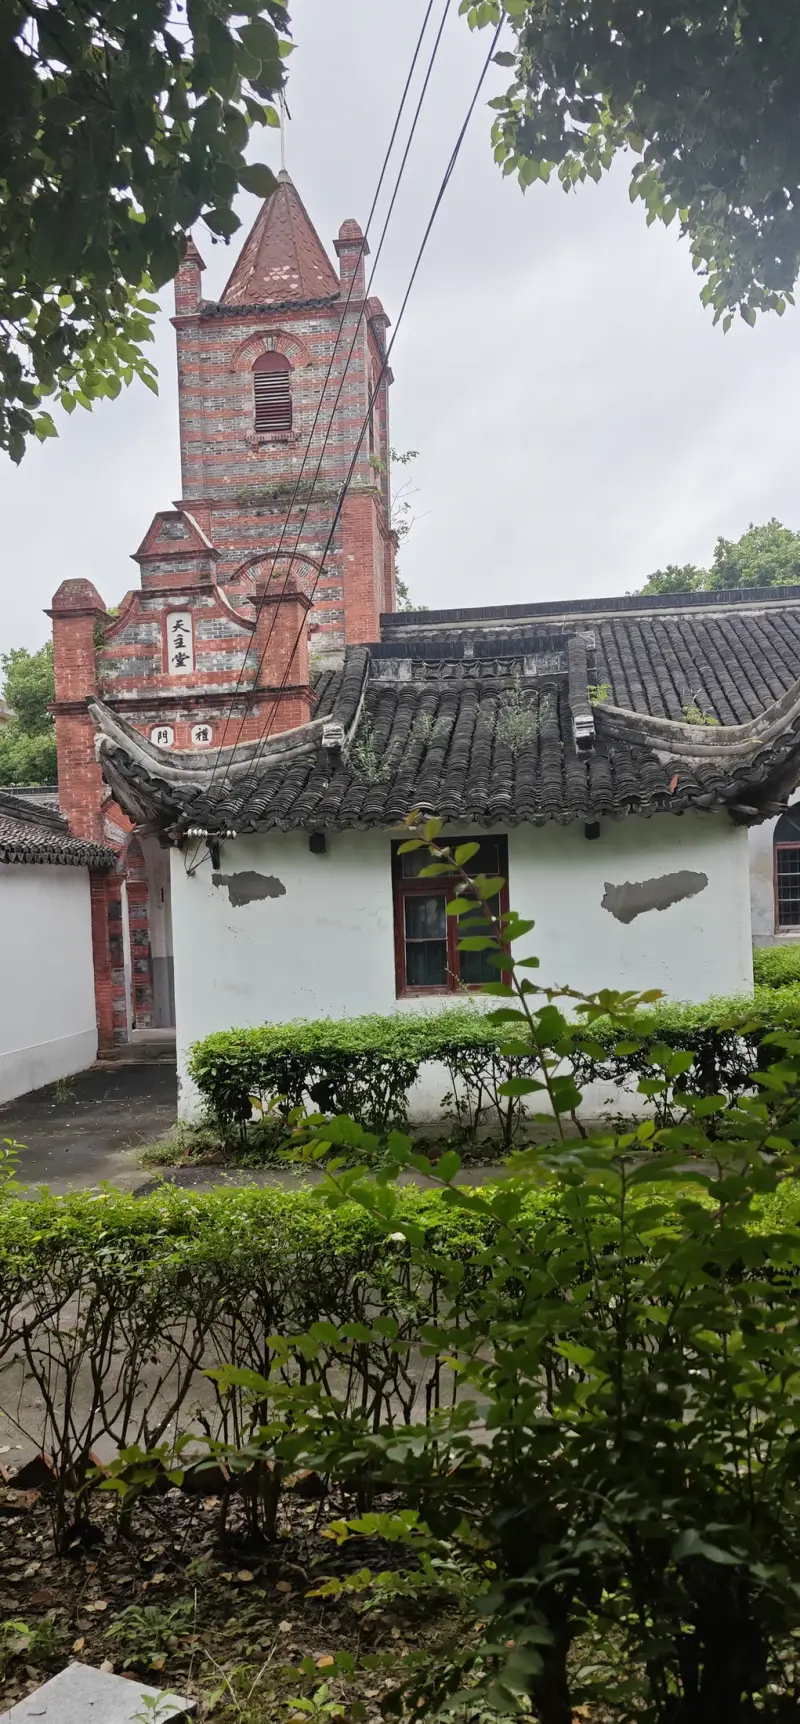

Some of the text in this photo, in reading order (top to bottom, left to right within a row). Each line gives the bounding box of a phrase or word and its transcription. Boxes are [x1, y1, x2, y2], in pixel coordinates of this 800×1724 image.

[171, 619, 191, 668] 天主堂
[157, 729, 169, 744] 門
[195, 727, 209, 742] 禮
